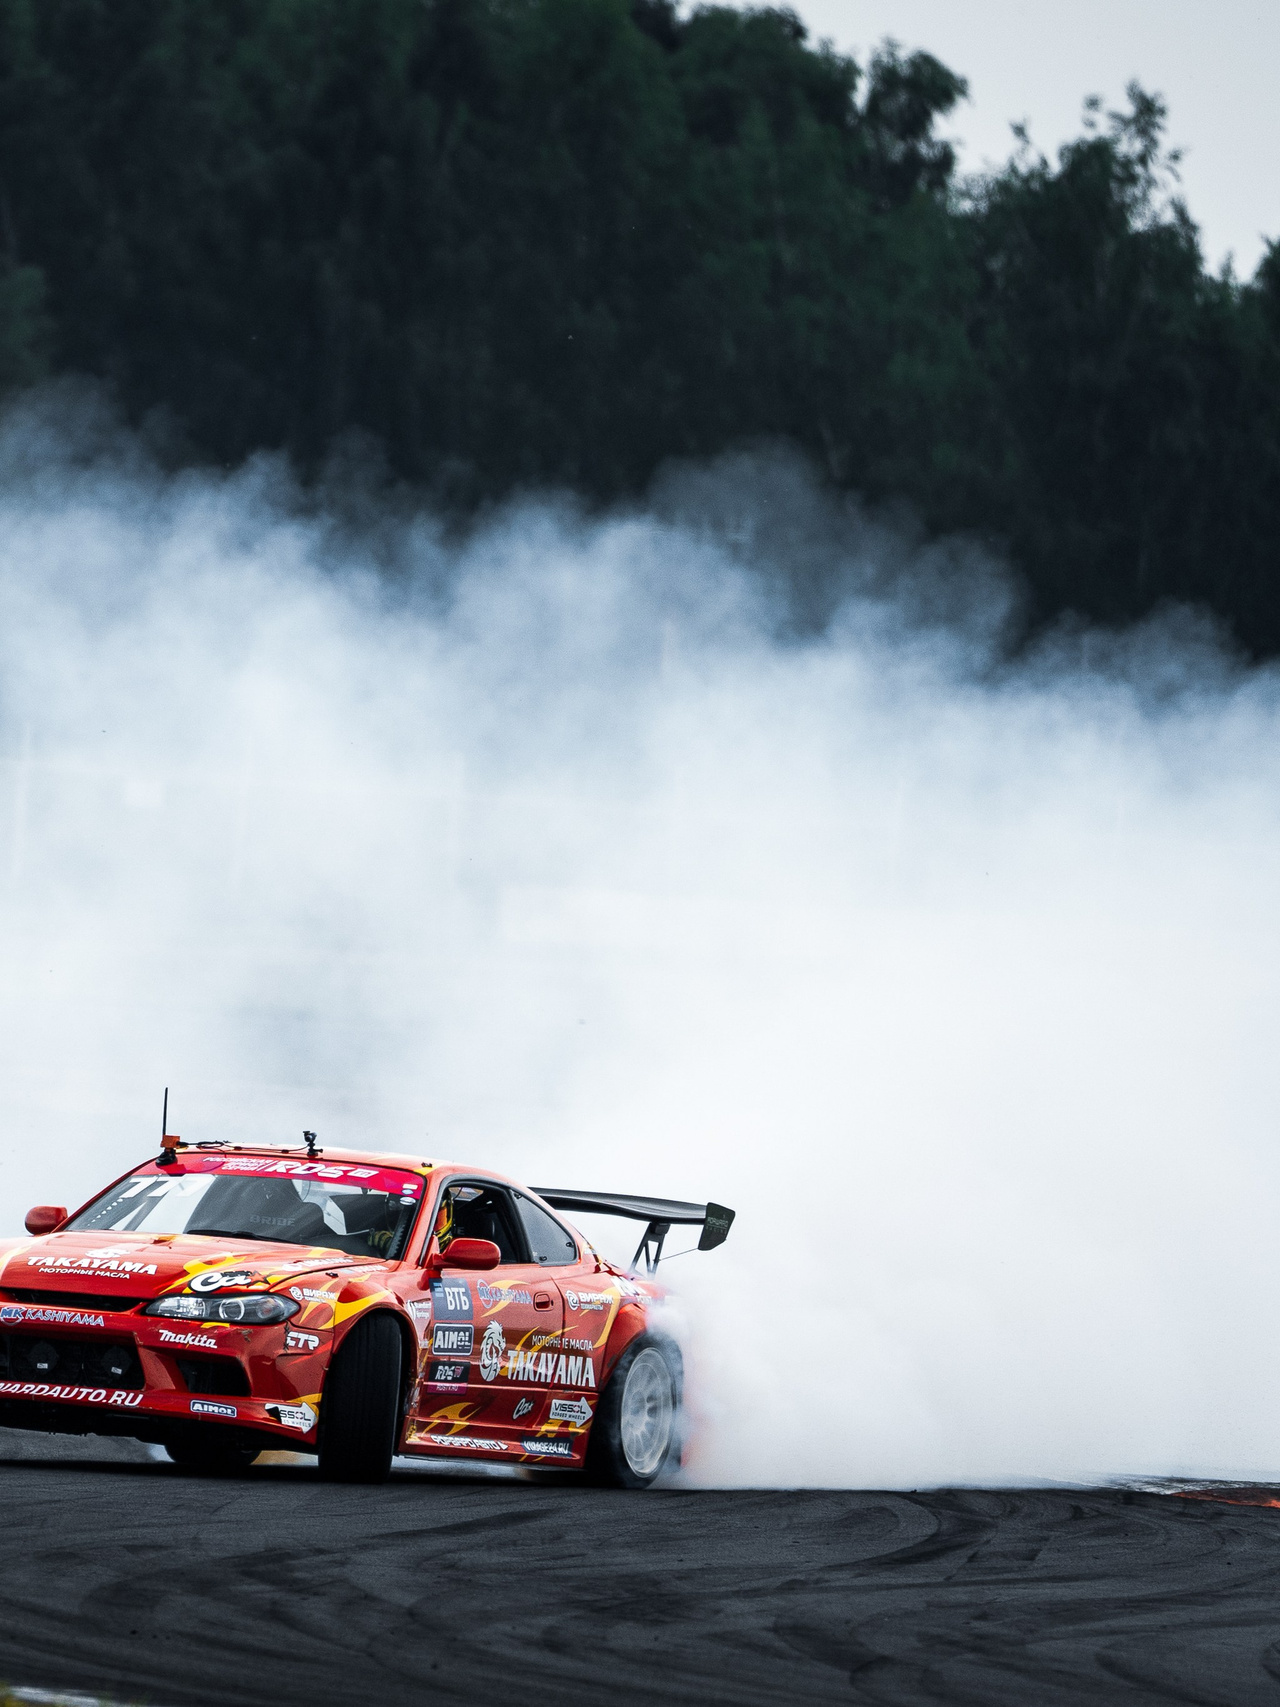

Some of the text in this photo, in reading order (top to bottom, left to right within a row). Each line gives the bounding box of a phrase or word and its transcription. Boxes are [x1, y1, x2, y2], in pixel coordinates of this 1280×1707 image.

[265, 1160, 356, 1178] RDS
[250, 1215, 296, 1227] BRIDE
[26, 1255, 158, 1275] TAKAYAMA
[38, 1267, 130, 1280] МОТОРНЫЕ МАСЛА
[302, 1288, 336, 1300] ВИРАЖ
[443, 1286, 470, 1311] ВТБ
[577, 1291, 614, 1304] ВИРАЖ
[24, 1309, 105, 1327] KASHIYAMA
[434, 1330, 471, 1349] AIMOL
[569, 1338, 594, 1351] МАСЛА
[507, 1350, 596, 1388] TAKAYAMA
[192, 1402, 235, 1417] AIMOL
[279, 1408, 312, 1422] SSOL
[554, 1402, 587, 1415] VISSOL
